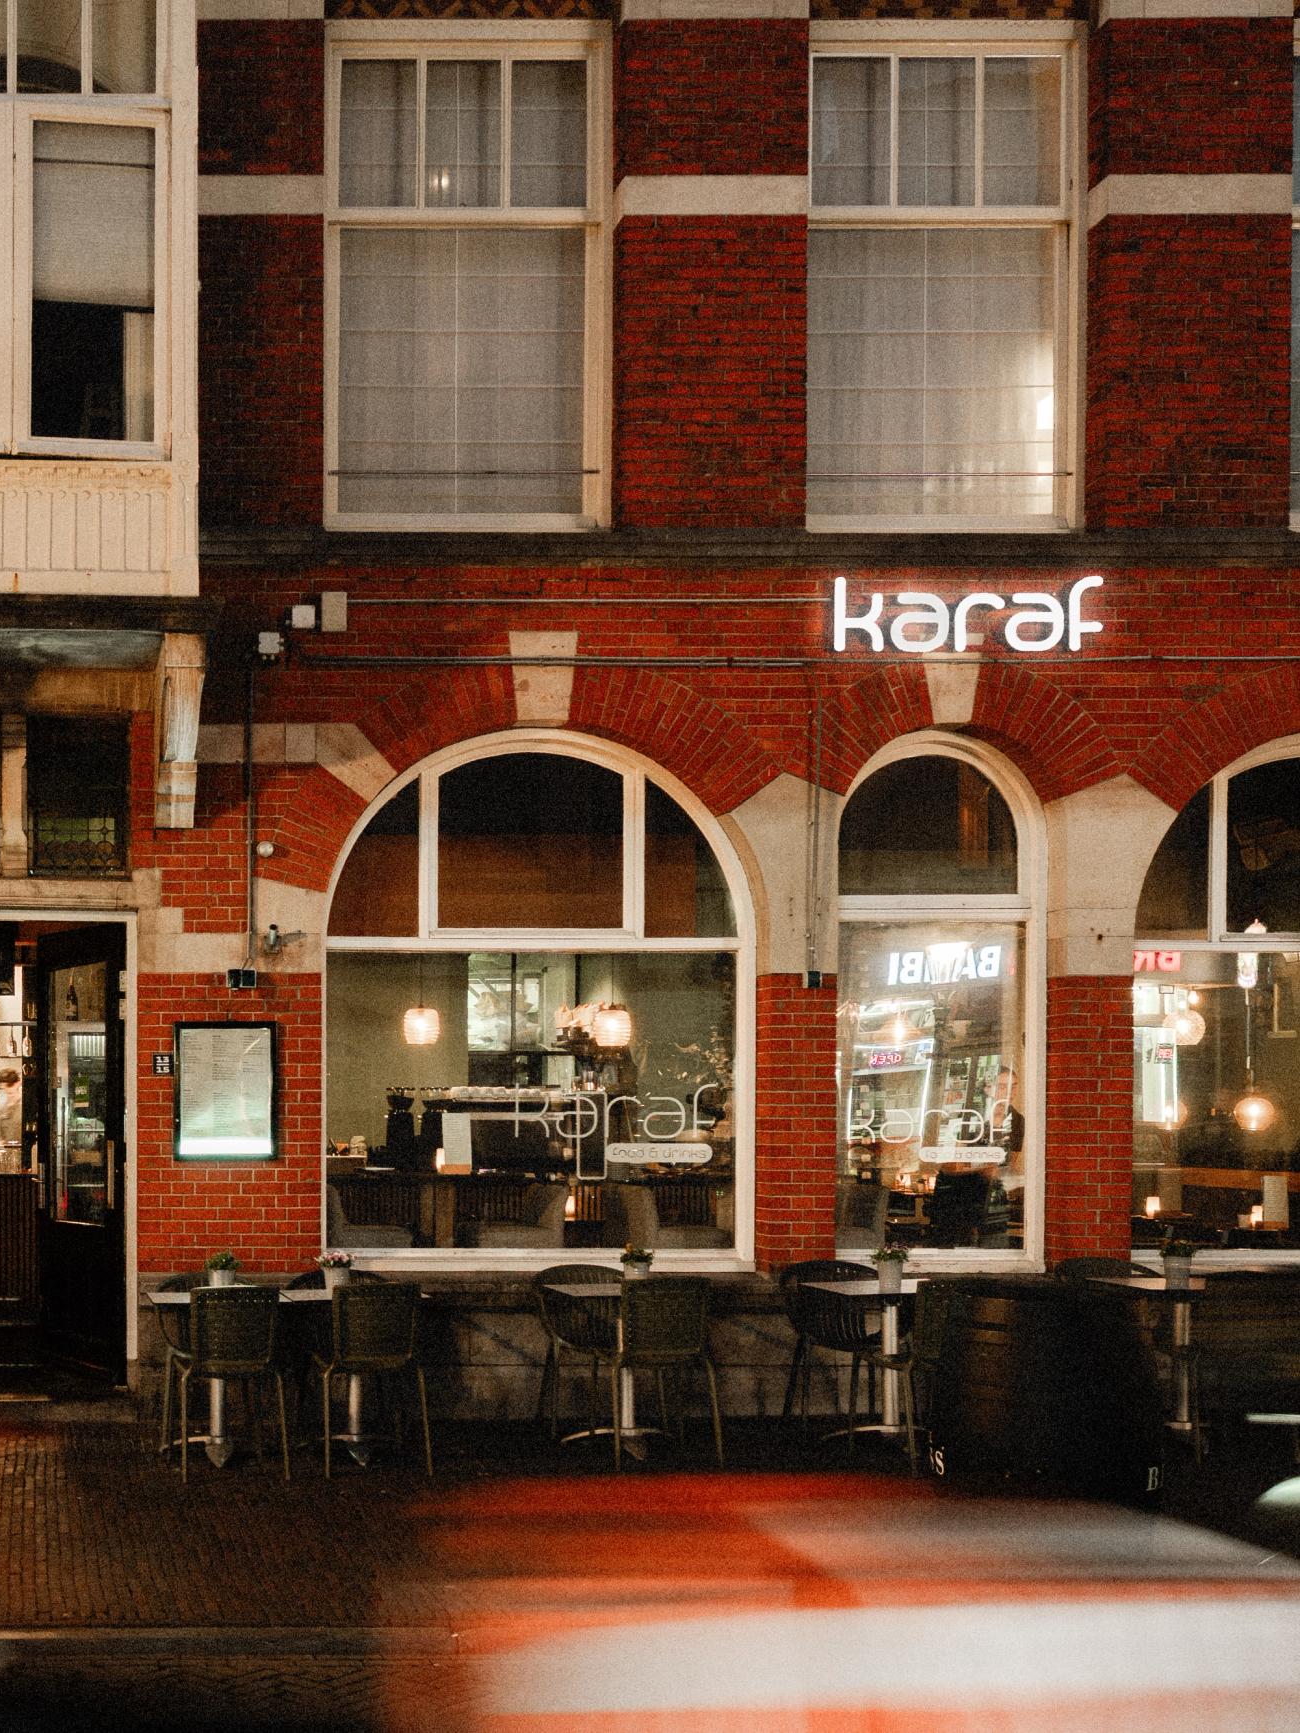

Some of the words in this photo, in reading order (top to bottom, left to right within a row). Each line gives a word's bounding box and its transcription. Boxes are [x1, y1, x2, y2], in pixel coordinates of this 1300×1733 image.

[833, 575, 1104, 652] karaf
[515, 1083, 719, 1138] karaf
[847, 1098, 1011, 1144] karaf
[663, 1147, 708, 1159] drinks
